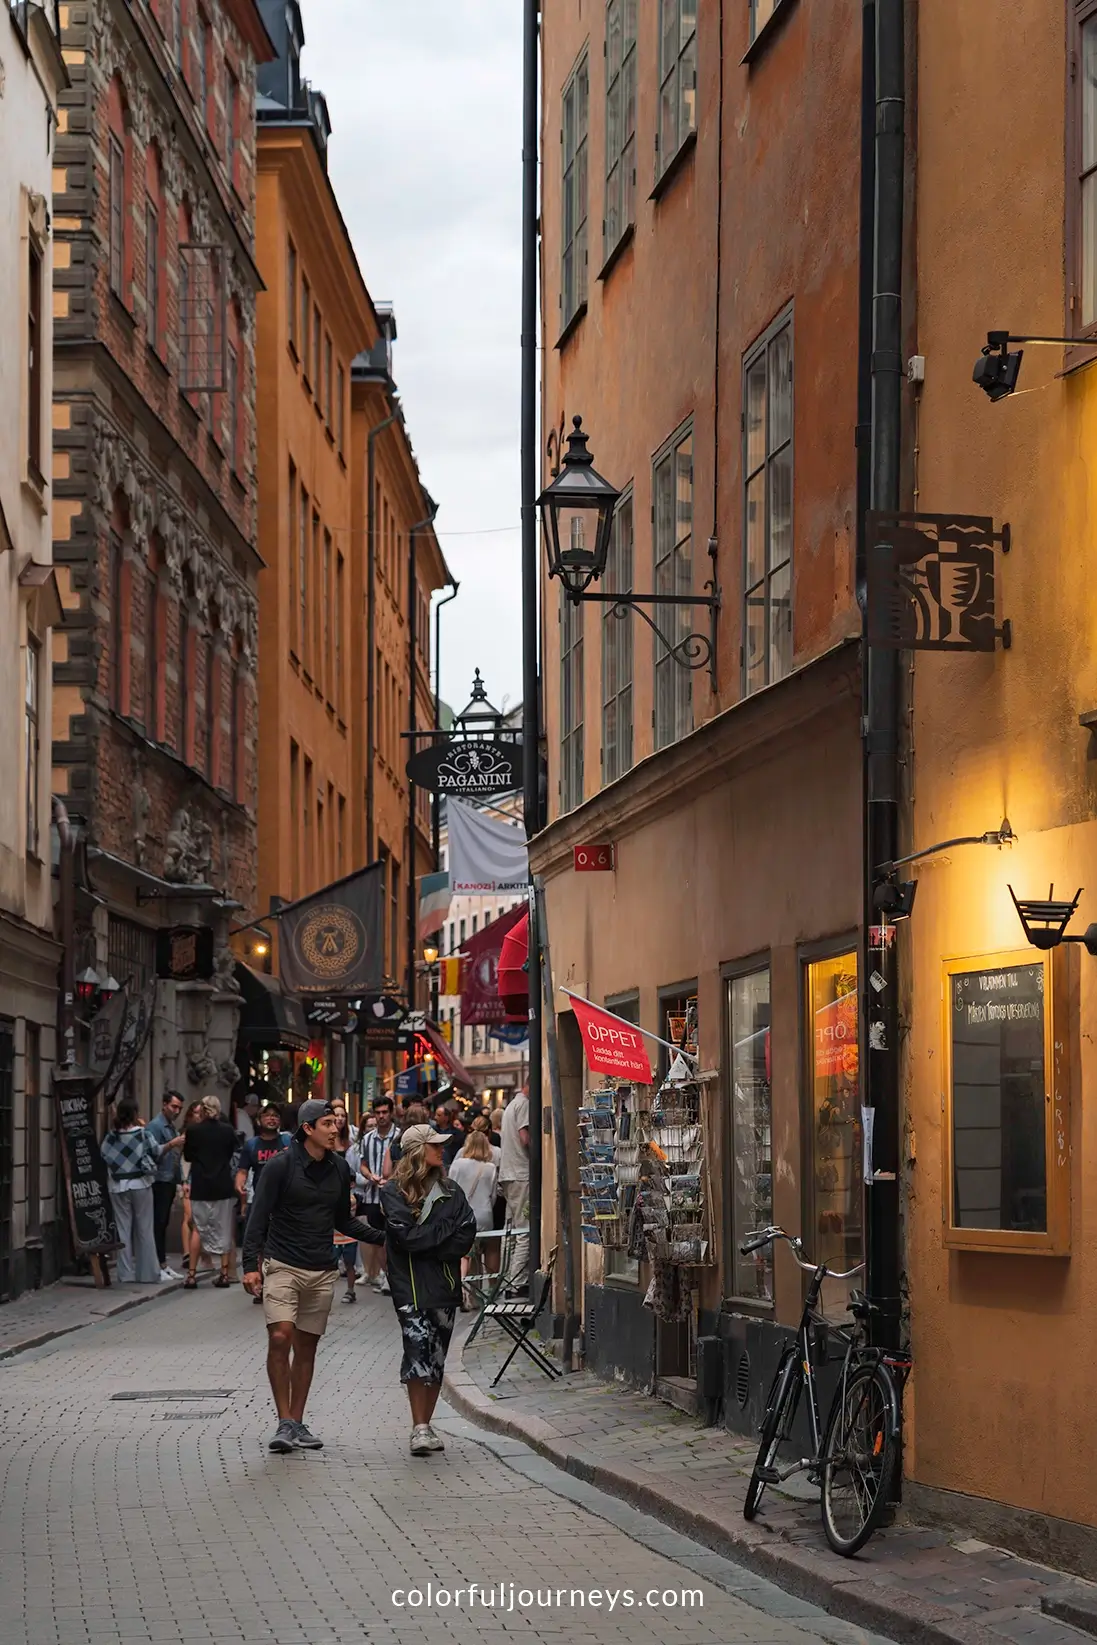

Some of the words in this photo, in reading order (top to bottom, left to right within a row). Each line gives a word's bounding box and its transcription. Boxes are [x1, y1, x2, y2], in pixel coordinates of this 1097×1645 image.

[448, 742, 501, 758] RISTORANTE
[437, 772, 512, 787] PAGANINI
[587, 1021, 637, 1048] ÖPPET
[592, 1045, 613, 1057] Ladda
[612, 1050, 625, 1059] ditt
[593, 1053, 630, 1067] kontantkort
